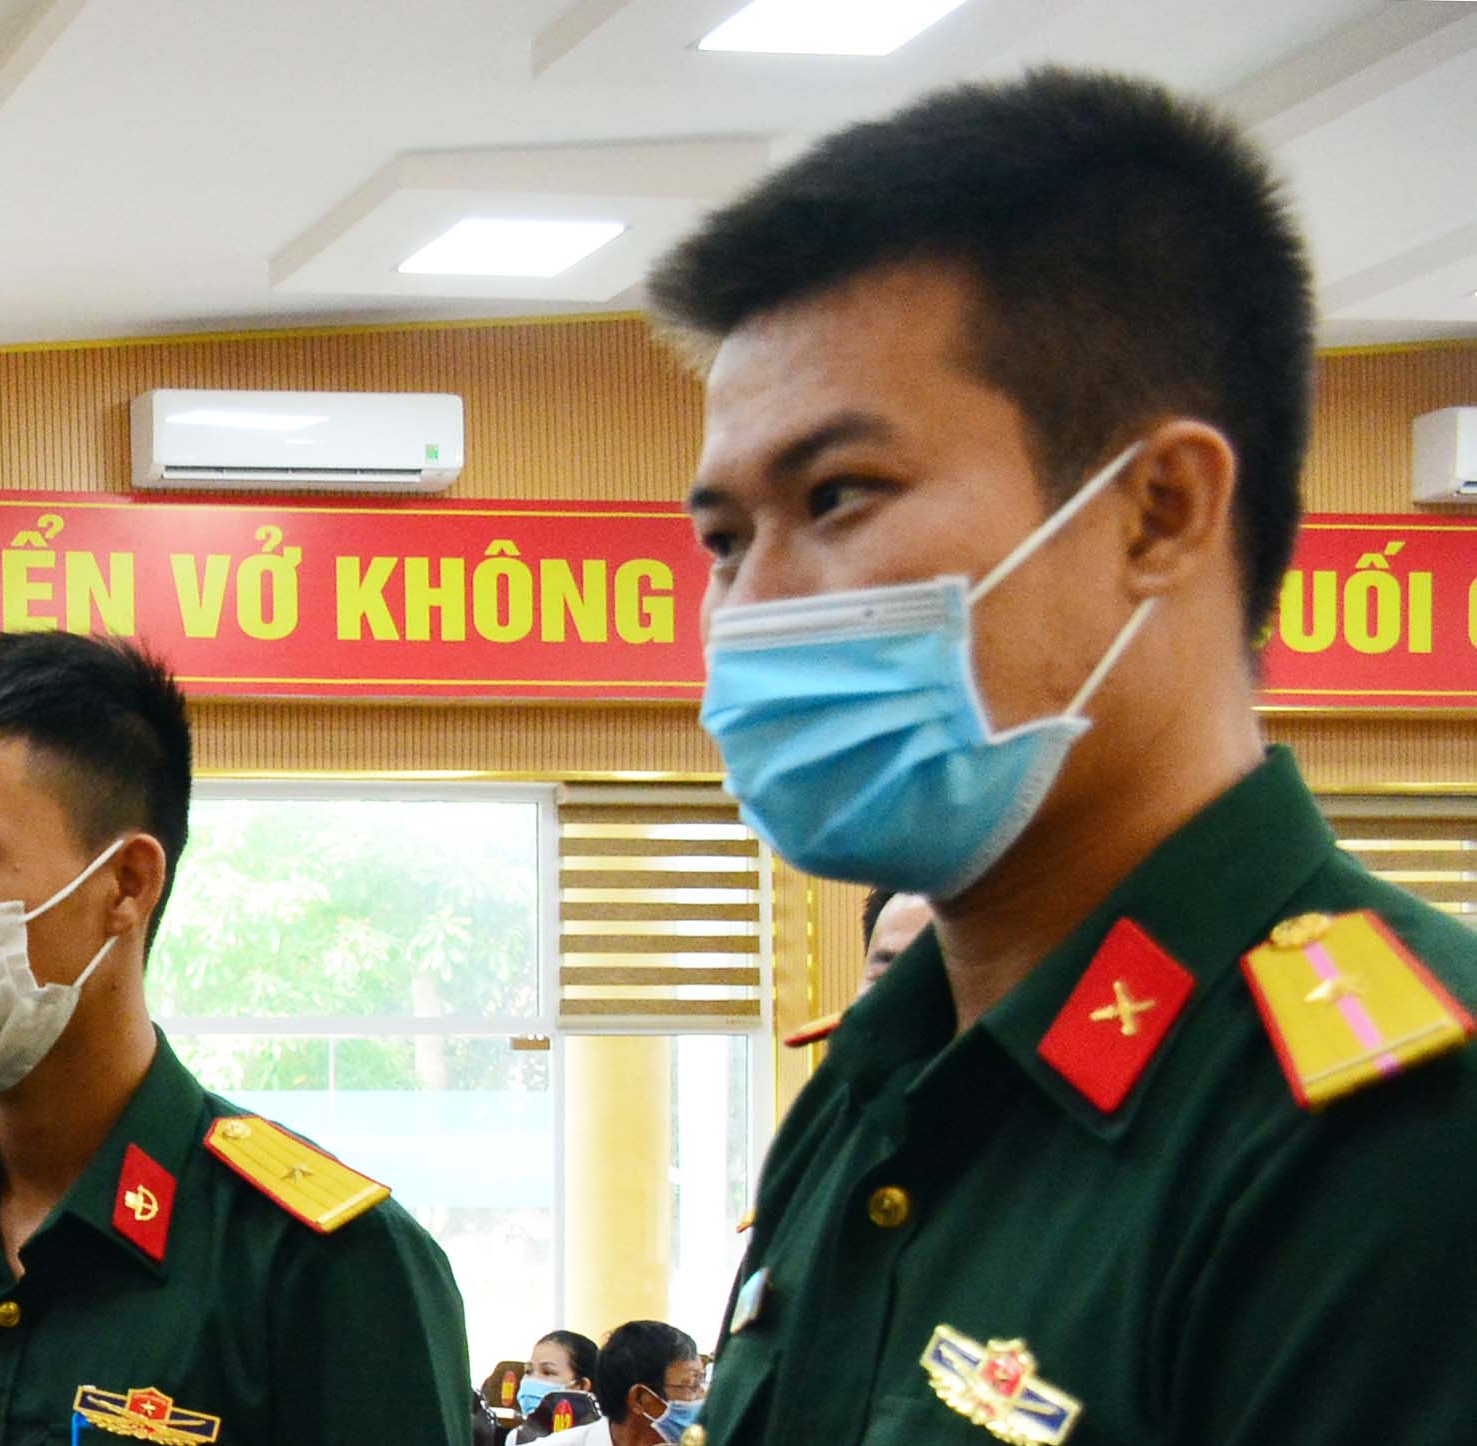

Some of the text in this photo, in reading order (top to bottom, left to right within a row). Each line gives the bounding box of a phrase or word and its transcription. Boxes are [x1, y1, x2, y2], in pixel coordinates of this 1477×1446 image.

[169, 525, 303, 641] VỞ
[335, 539, 676, 645] KHÔNG
[1251, 540, 1434, 654] UỐI
